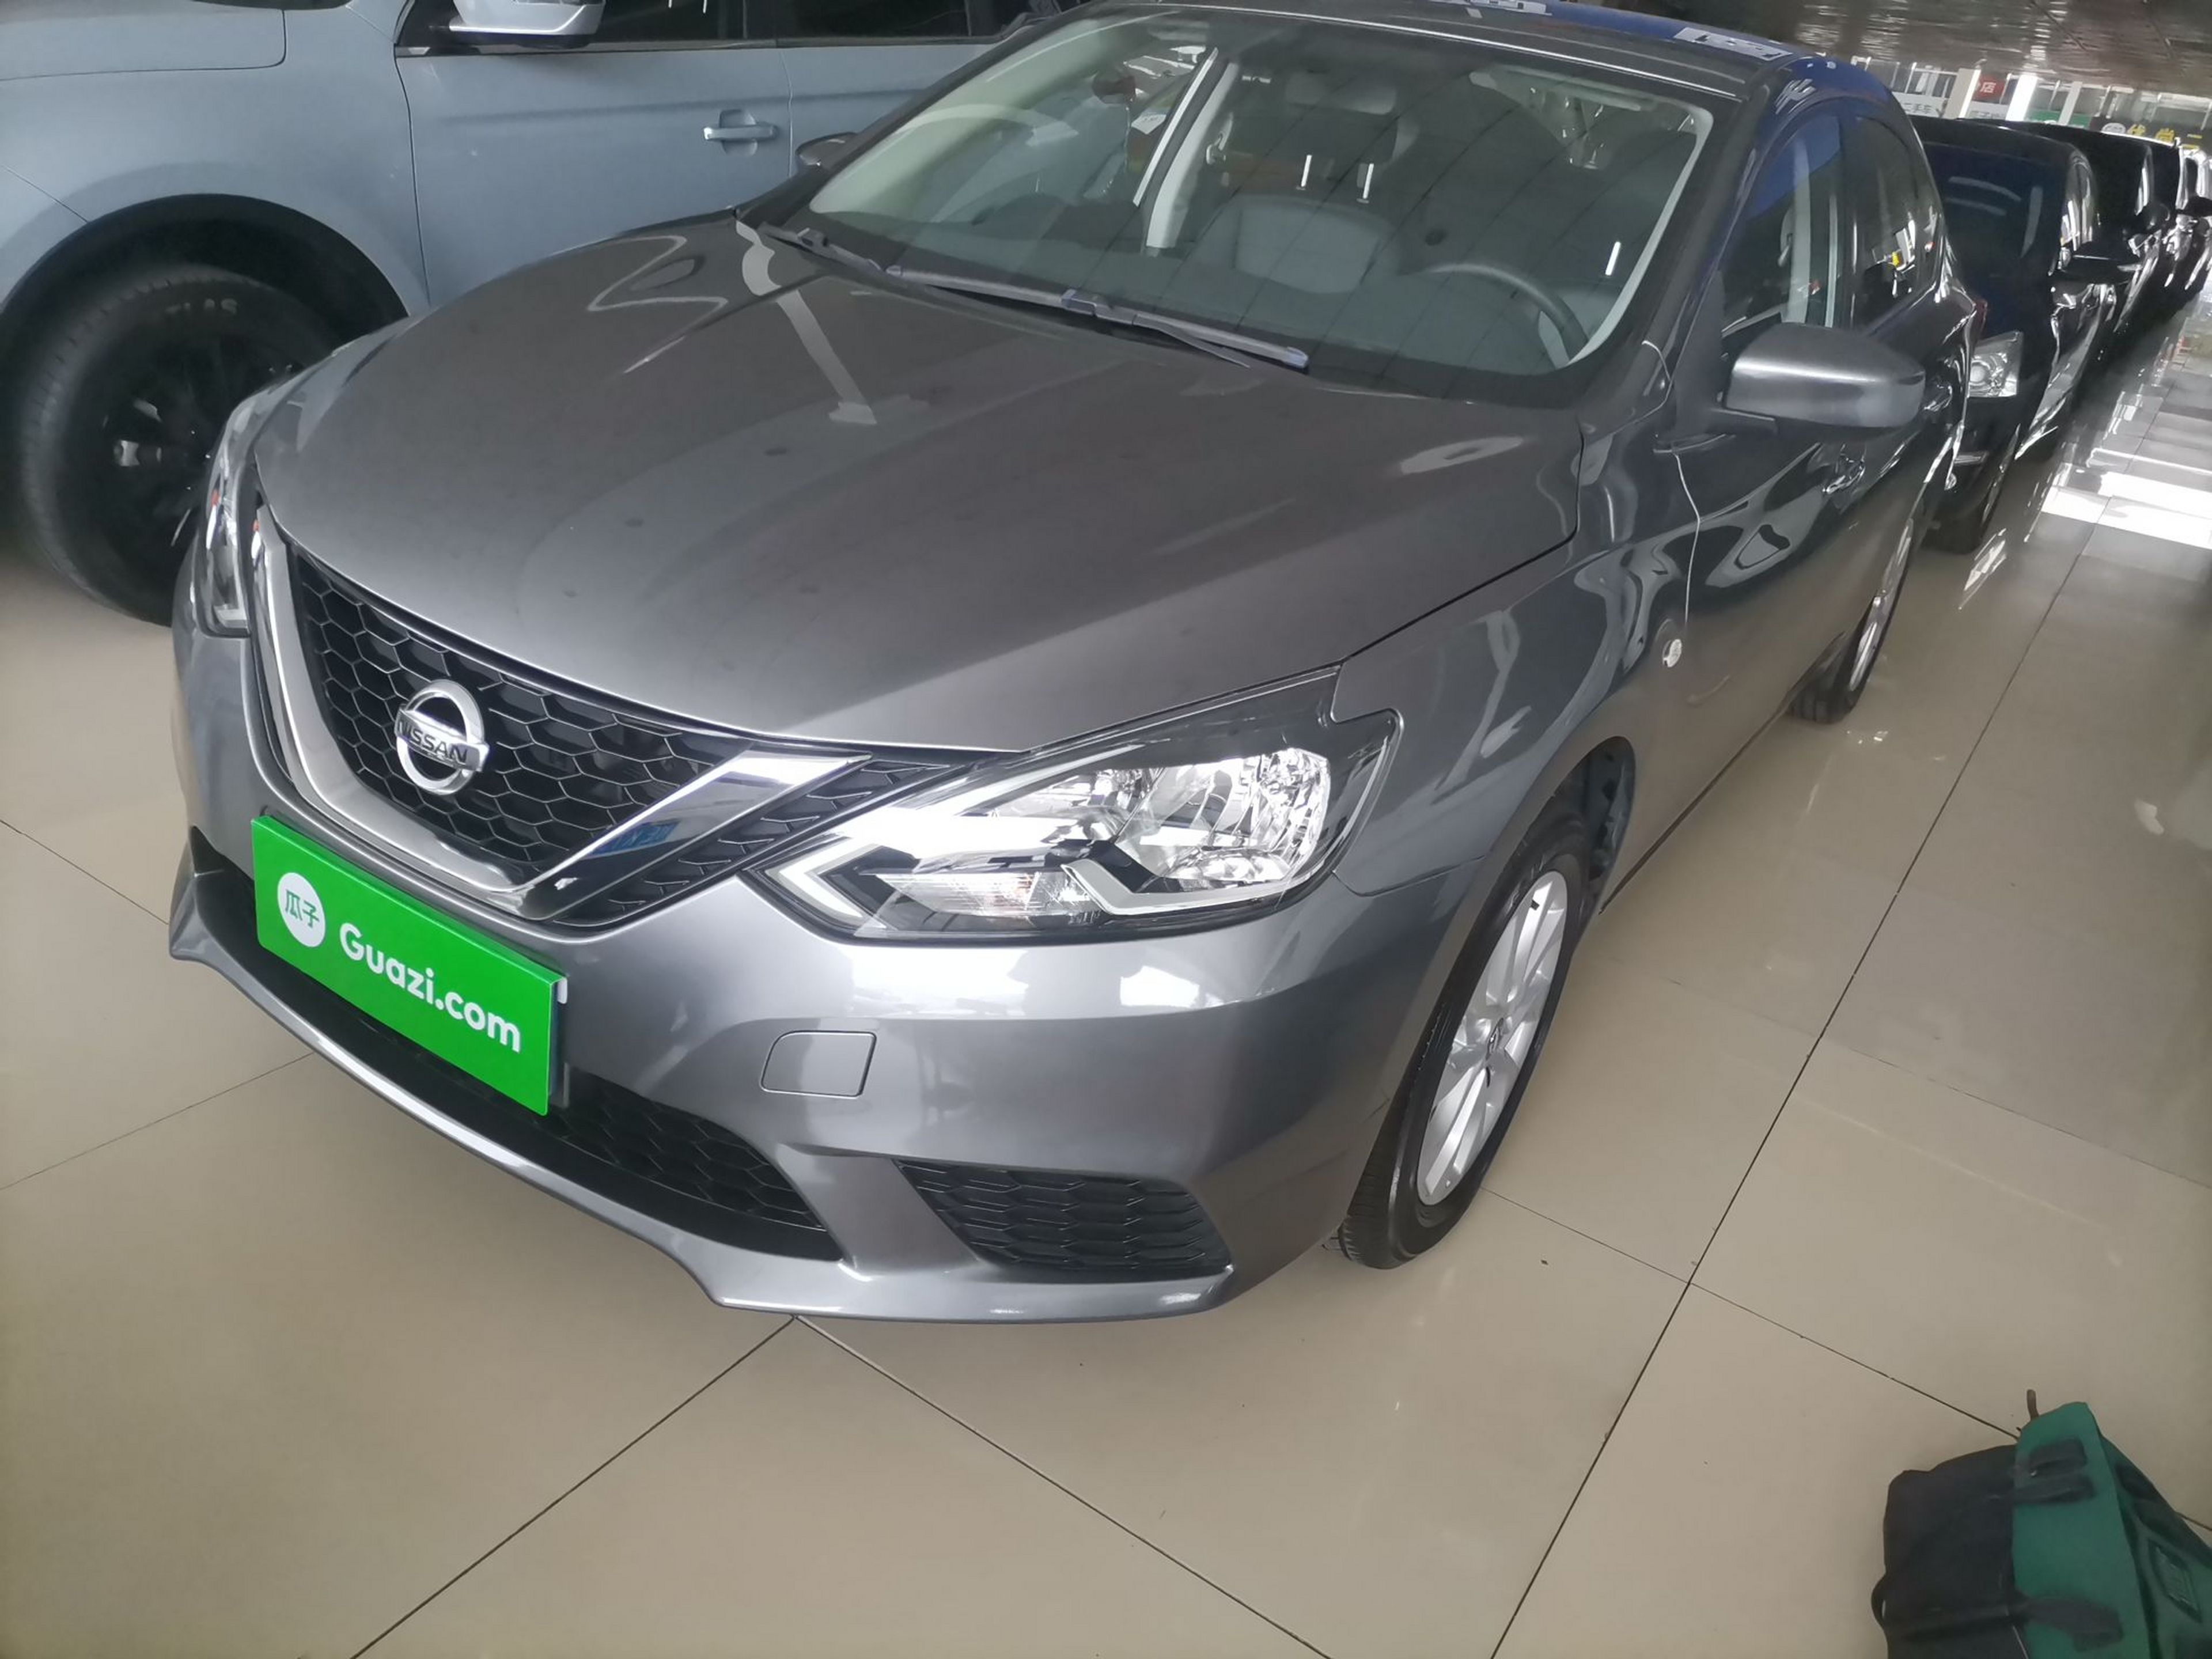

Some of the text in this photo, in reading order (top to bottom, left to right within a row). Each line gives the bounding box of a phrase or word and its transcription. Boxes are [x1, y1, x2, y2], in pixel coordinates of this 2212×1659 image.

[398, 720, 468, 765] NISSAN
[285, 889, 320, 929] 瓜子
[340, 923, 521, 1052] Guazi.com
